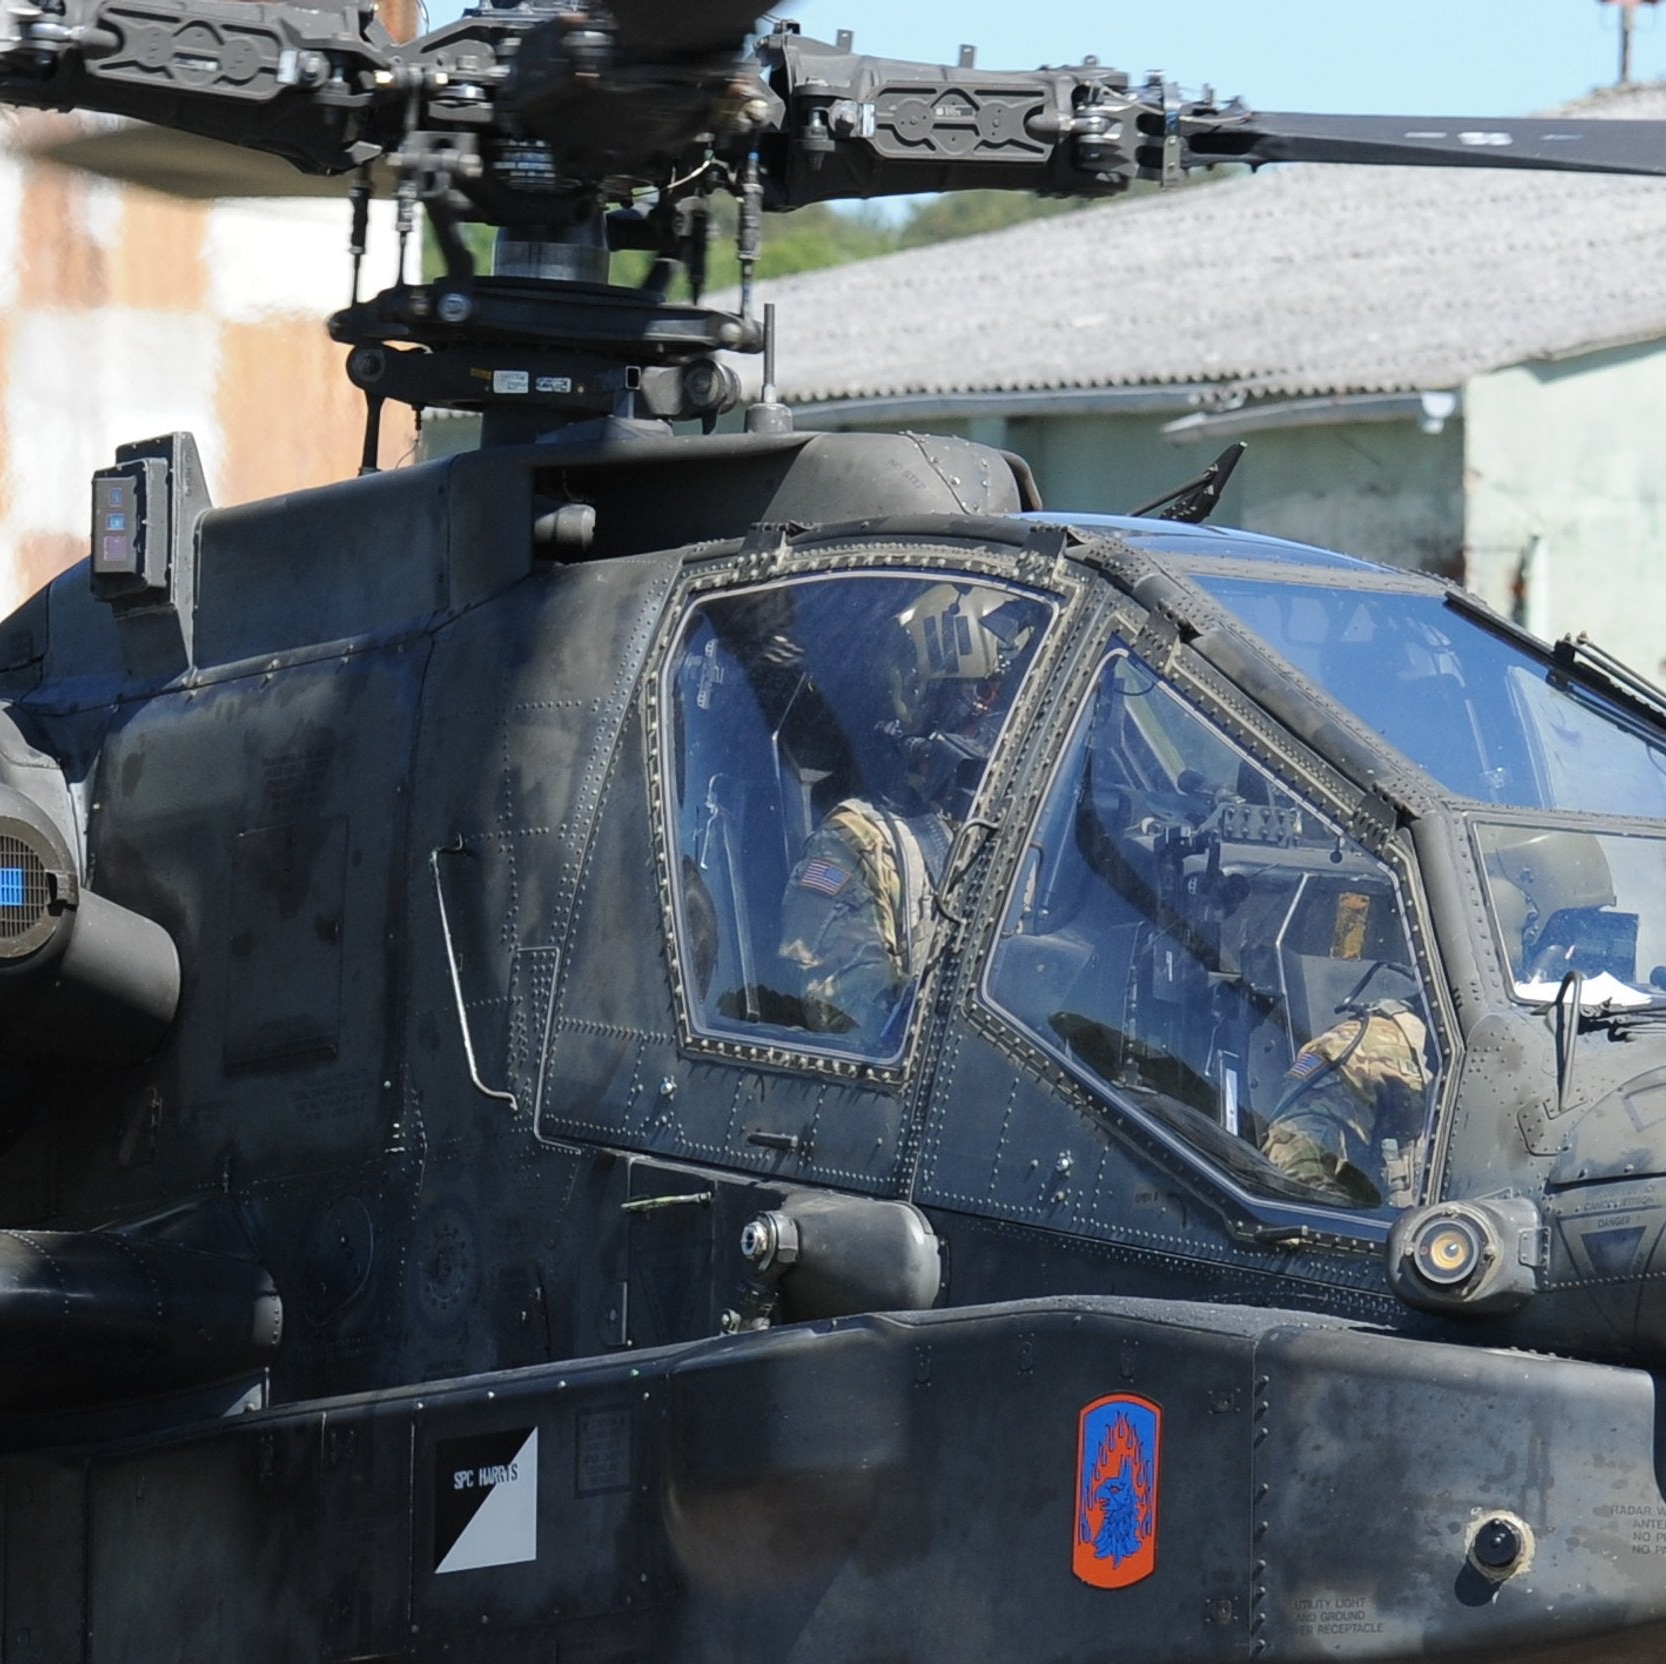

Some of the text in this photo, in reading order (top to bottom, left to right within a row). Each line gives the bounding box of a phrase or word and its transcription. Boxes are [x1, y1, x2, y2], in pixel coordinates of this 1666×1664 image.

[454, 1463, 519, 1490] SPC HARRIS
[1610, 1504, 1652, 1516] RADAR
[1632, 1531, 1651, 1542] NO
[1631, 1545, 1651, 1555] NO
[1294, 1597, 1365, 1609] UTILITY LIGHT
[1296, 1610, 1365, 1622] AND GROUND
[1317, 1622, 1385, 1635] RECEPTACLE
